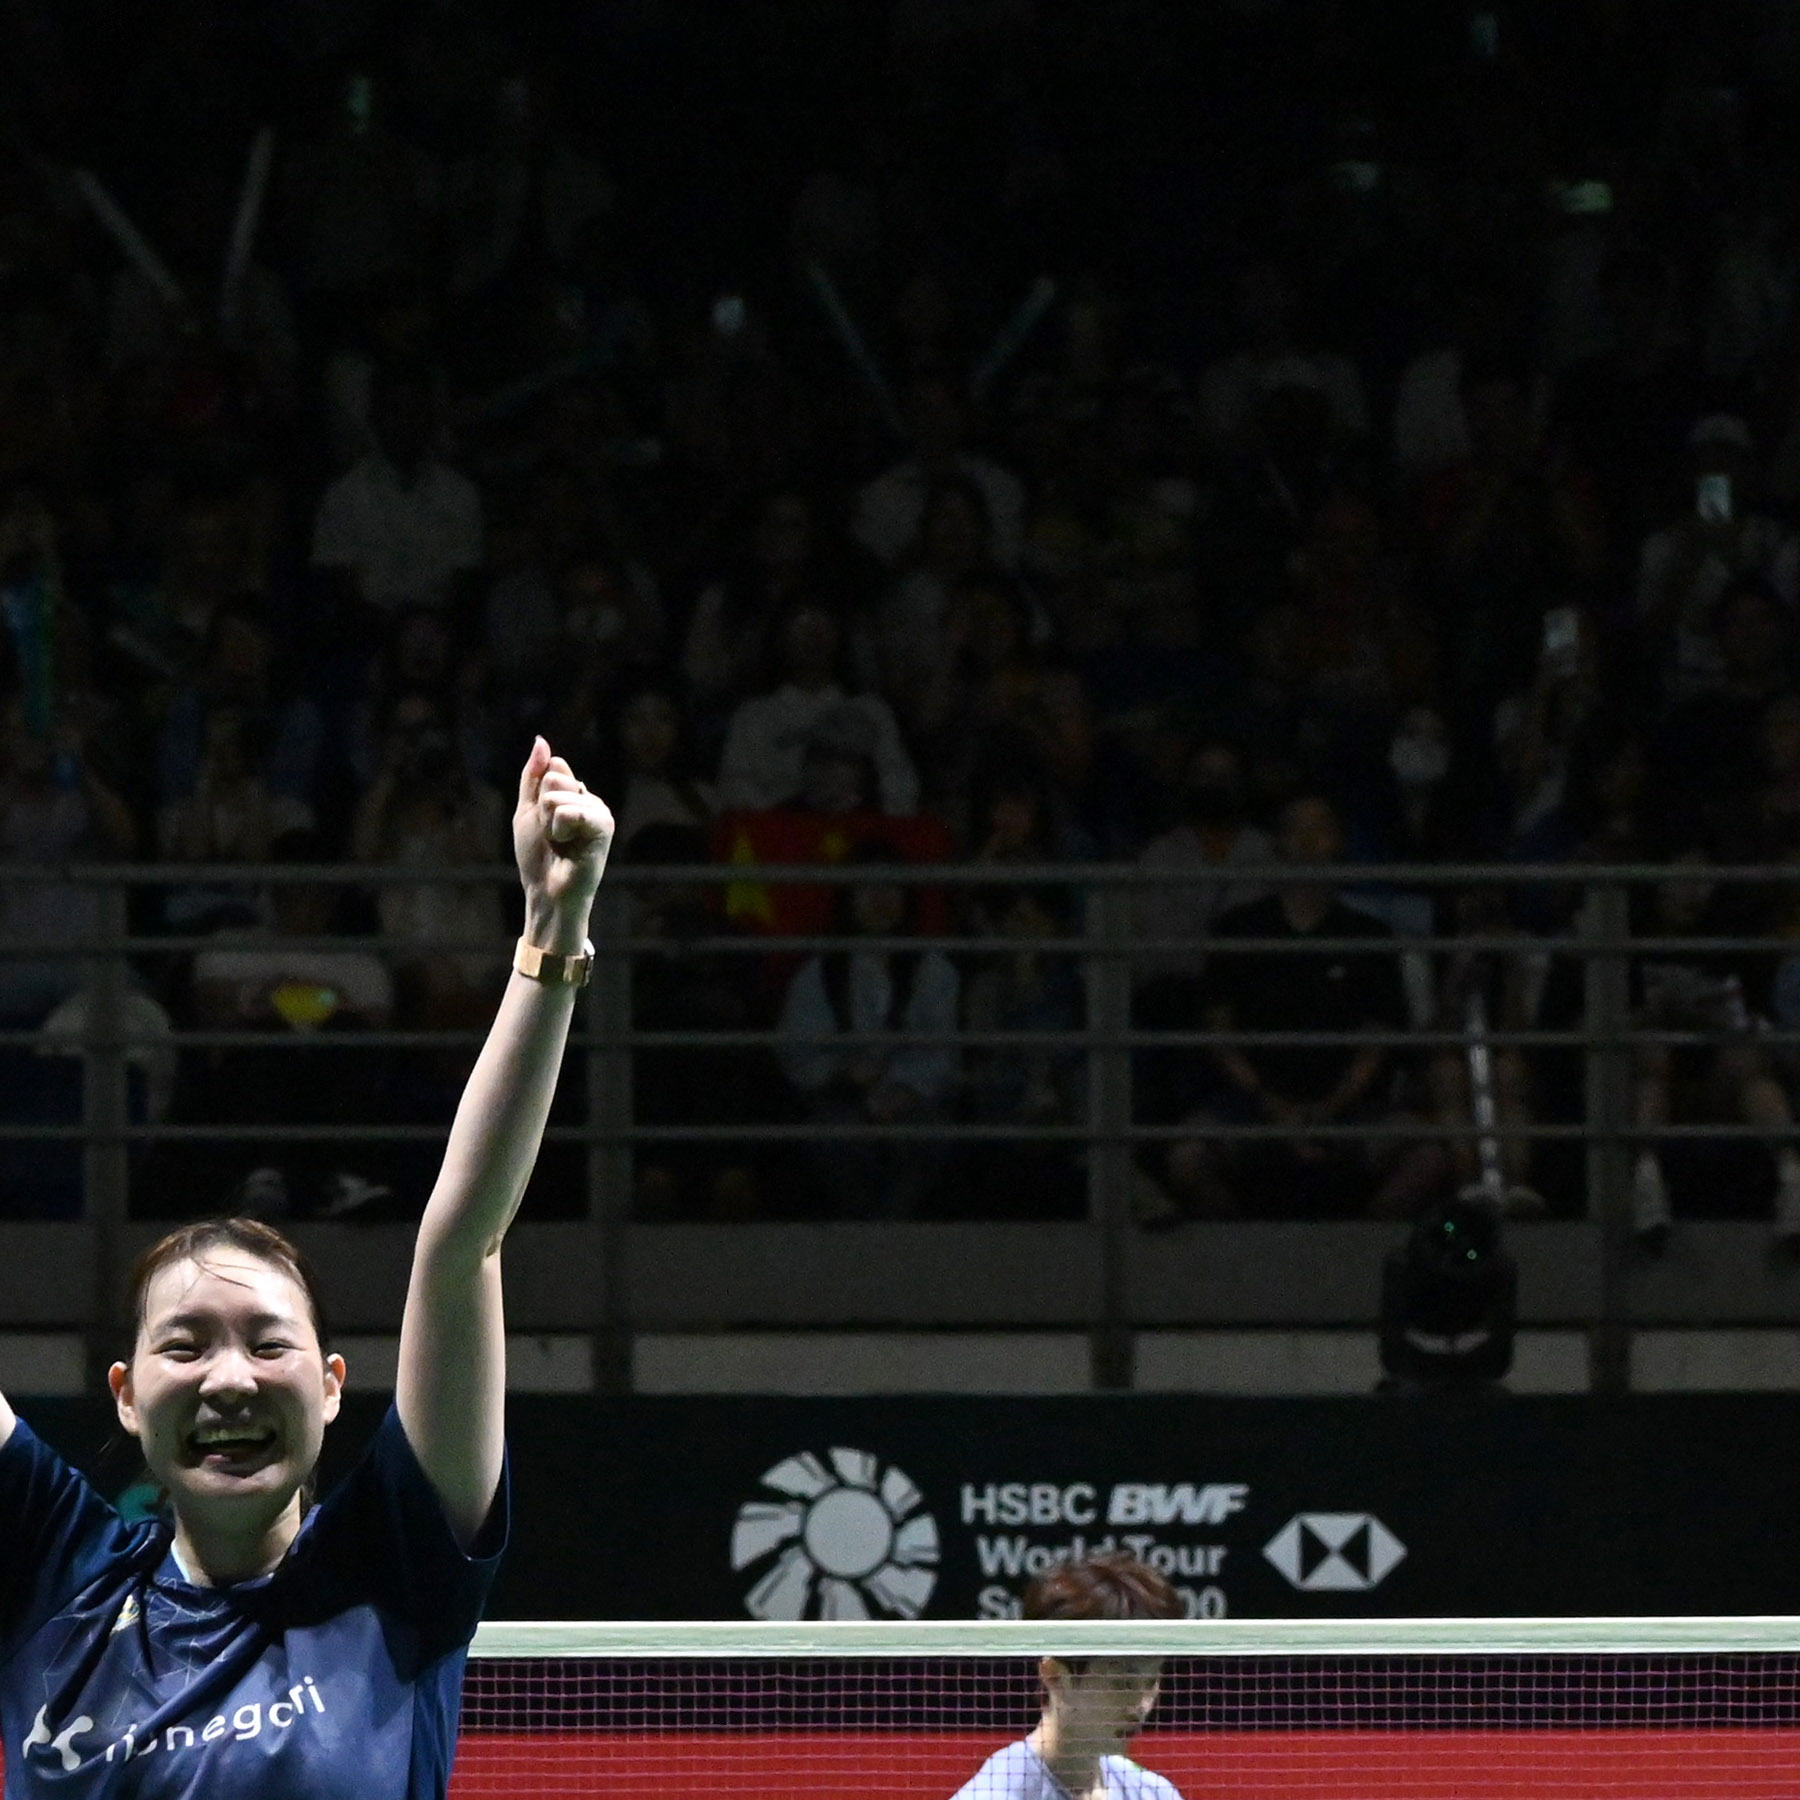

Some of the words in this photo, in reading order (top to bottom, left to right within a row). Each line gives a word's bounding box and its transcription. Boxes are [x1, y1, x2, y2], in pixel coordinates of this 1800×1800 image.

[960, 1482, 1098, 1526] HSBC
[1105, 1482, 1251, 1526] BWF
[1120, 1533, 1229, 1577] Tour
